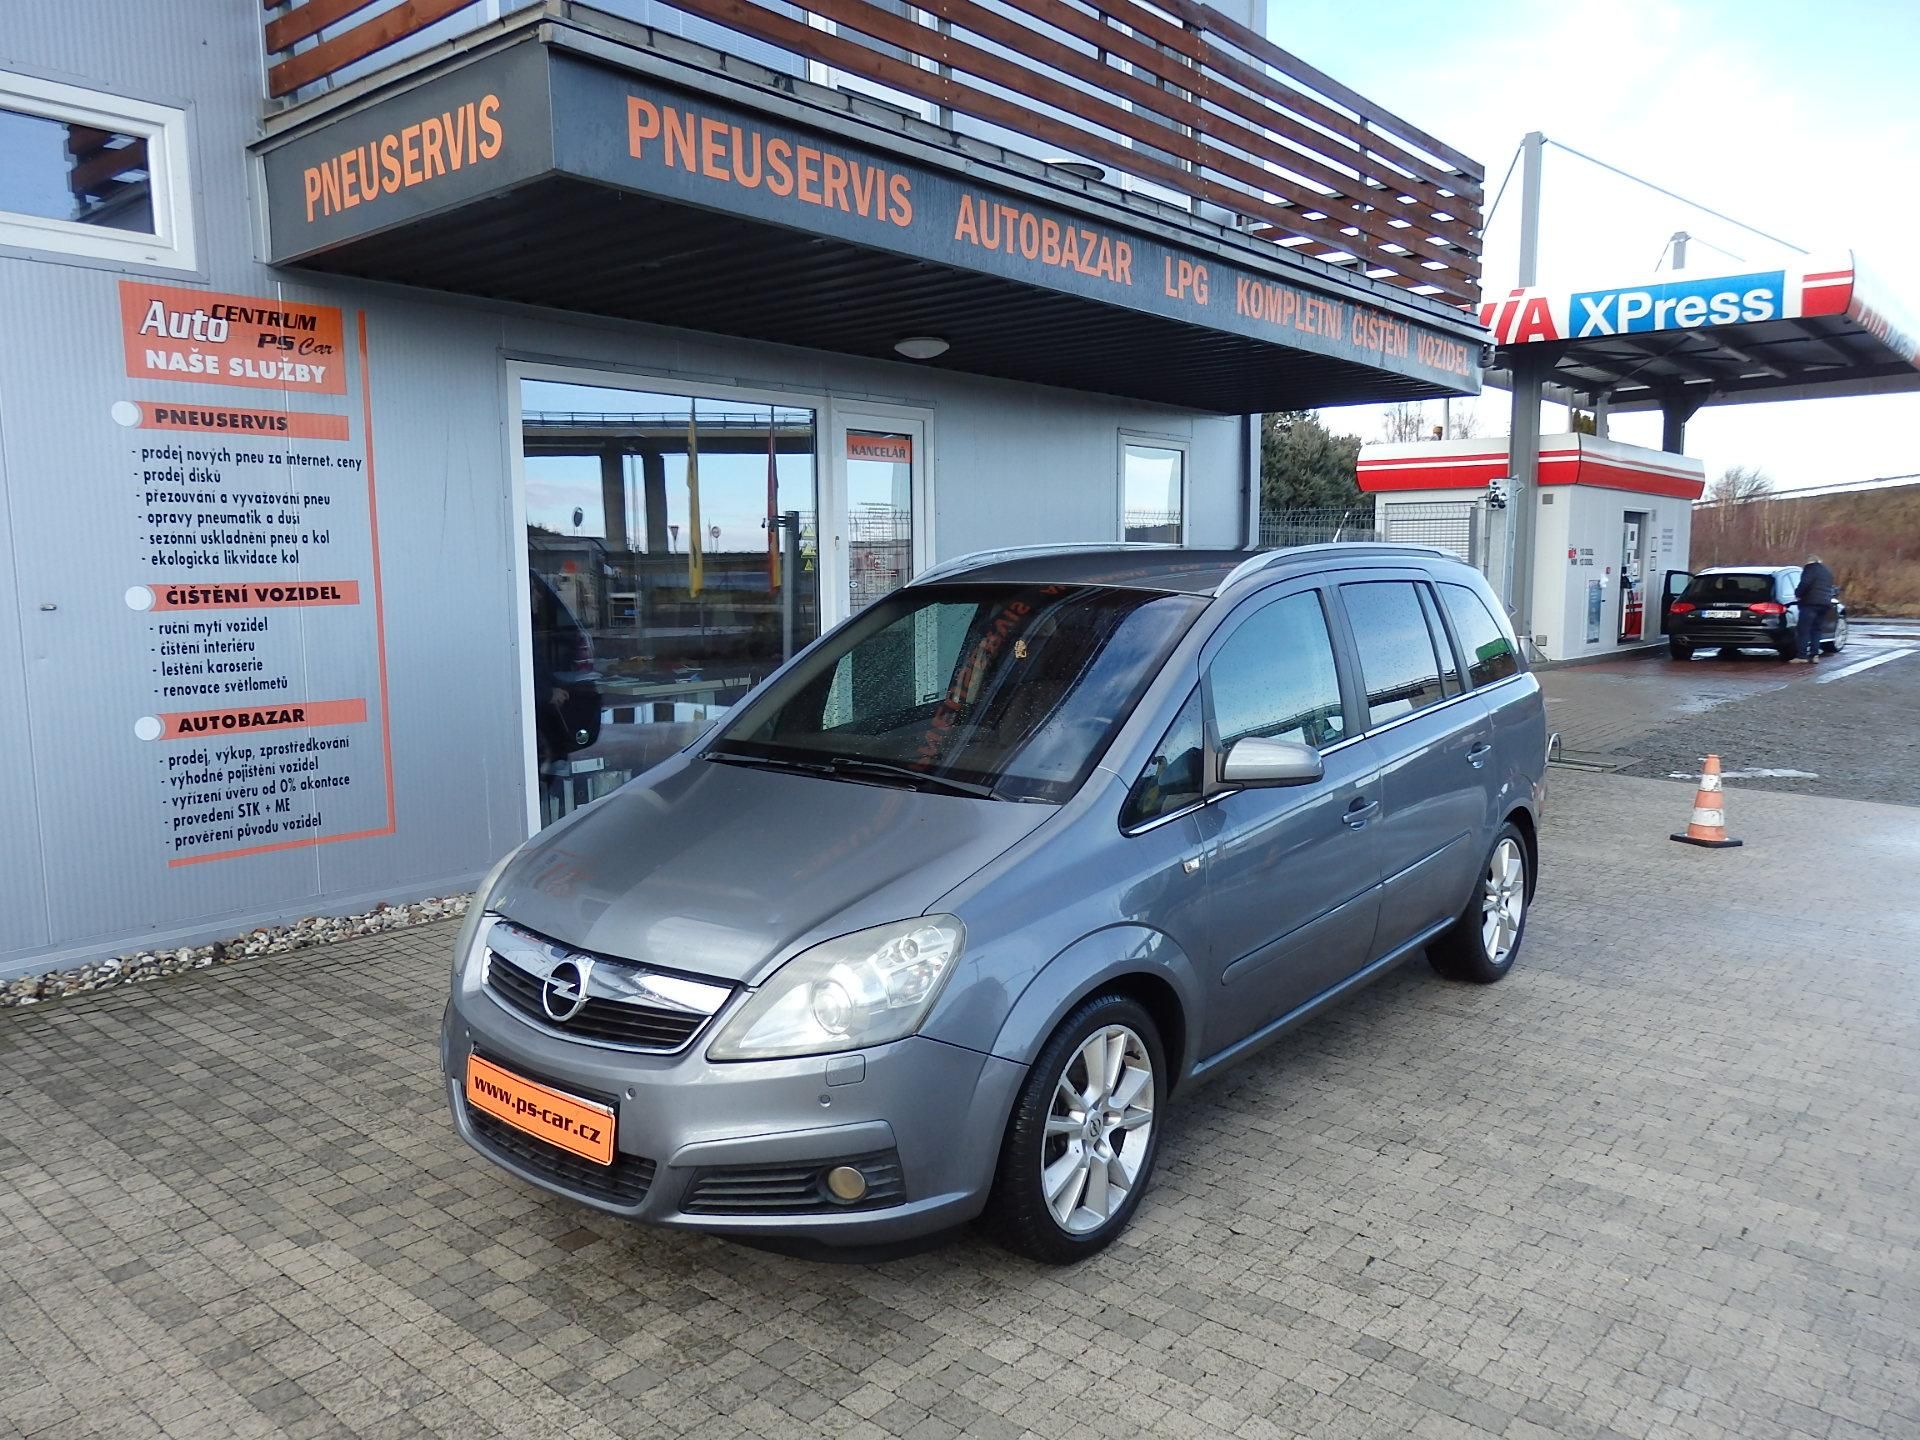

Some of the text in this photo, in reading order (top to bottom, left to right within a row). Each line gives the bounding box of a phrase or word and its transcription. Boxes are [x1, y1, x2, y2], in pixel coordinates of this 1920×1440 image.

[303, 94, 503, 223] PNEUSERVIS
[626, 95, 1471, 377] PNEUSERVIS AUTOBAZAR LPG KOMPLETNÍ ČIŠTĚNÍ VOZIDEL
[138, 299, 317, 344] Auto CENTRUM
[1578, 288, 1775, 338] XPress
[257, 333, 334, 356] PS Car
[145, 348, 326, 384] NAŠE SLUŽBY
[155, 408, 288, 431] PNEUSERVIS
[142, 445, 183, 464] prodej
[187, 447, 231, 465] nových
[236, 452, 264, 466] pneu
[268, 453, 282, 464] za
[337, 457, 362, 471] ceny
[851, 444, 906, 459] KANCELÁŘ
[143, 466, 184, 485] prodej
[145, 489, 331, 508] přezouvání a vyvažování pneu
[147, 513, 192, 527] opravy
[198, 509, 262, 527] pneumatik
[266, 514, 273, 524] a
[150, 529, 330, 547] sezónní uskladnění pneu a kol
[152, 549, 299, 569] ekologická likvidace kol
[166, 583, 341, 605] ČIŠTĚNÍ VOZIDEL
[159, 616, 268, 636] ruční mytí vozidel
[160, 637, 255, 656] čištění interiéru
[162, 656, 263, 676] leštění karoserie
[164, 676, 288, 697] renovace světlometů
[178, 708, 305, 733] AUTOBAZAR
[169, 749, 211, 770] prodej,
[260, 735, 350, 759] zprostředkování
[170, 756, 319, 789] výhodné pojištění vozidel
[172, 790, 222, 809] vyřízení
[262, 780, 276, 795] od
[280, 777, 297, 793] 0%
[300, 775, 350, 791] akontace
[174, 808, 234, 831] provedení
[238, 801, 261, 818] STK
[275, 797, 291, 813] ME
[175, 812, 322, 851] prověření původu vozidel
[474, 1076, 601, 1145] www.ps-car.cz
